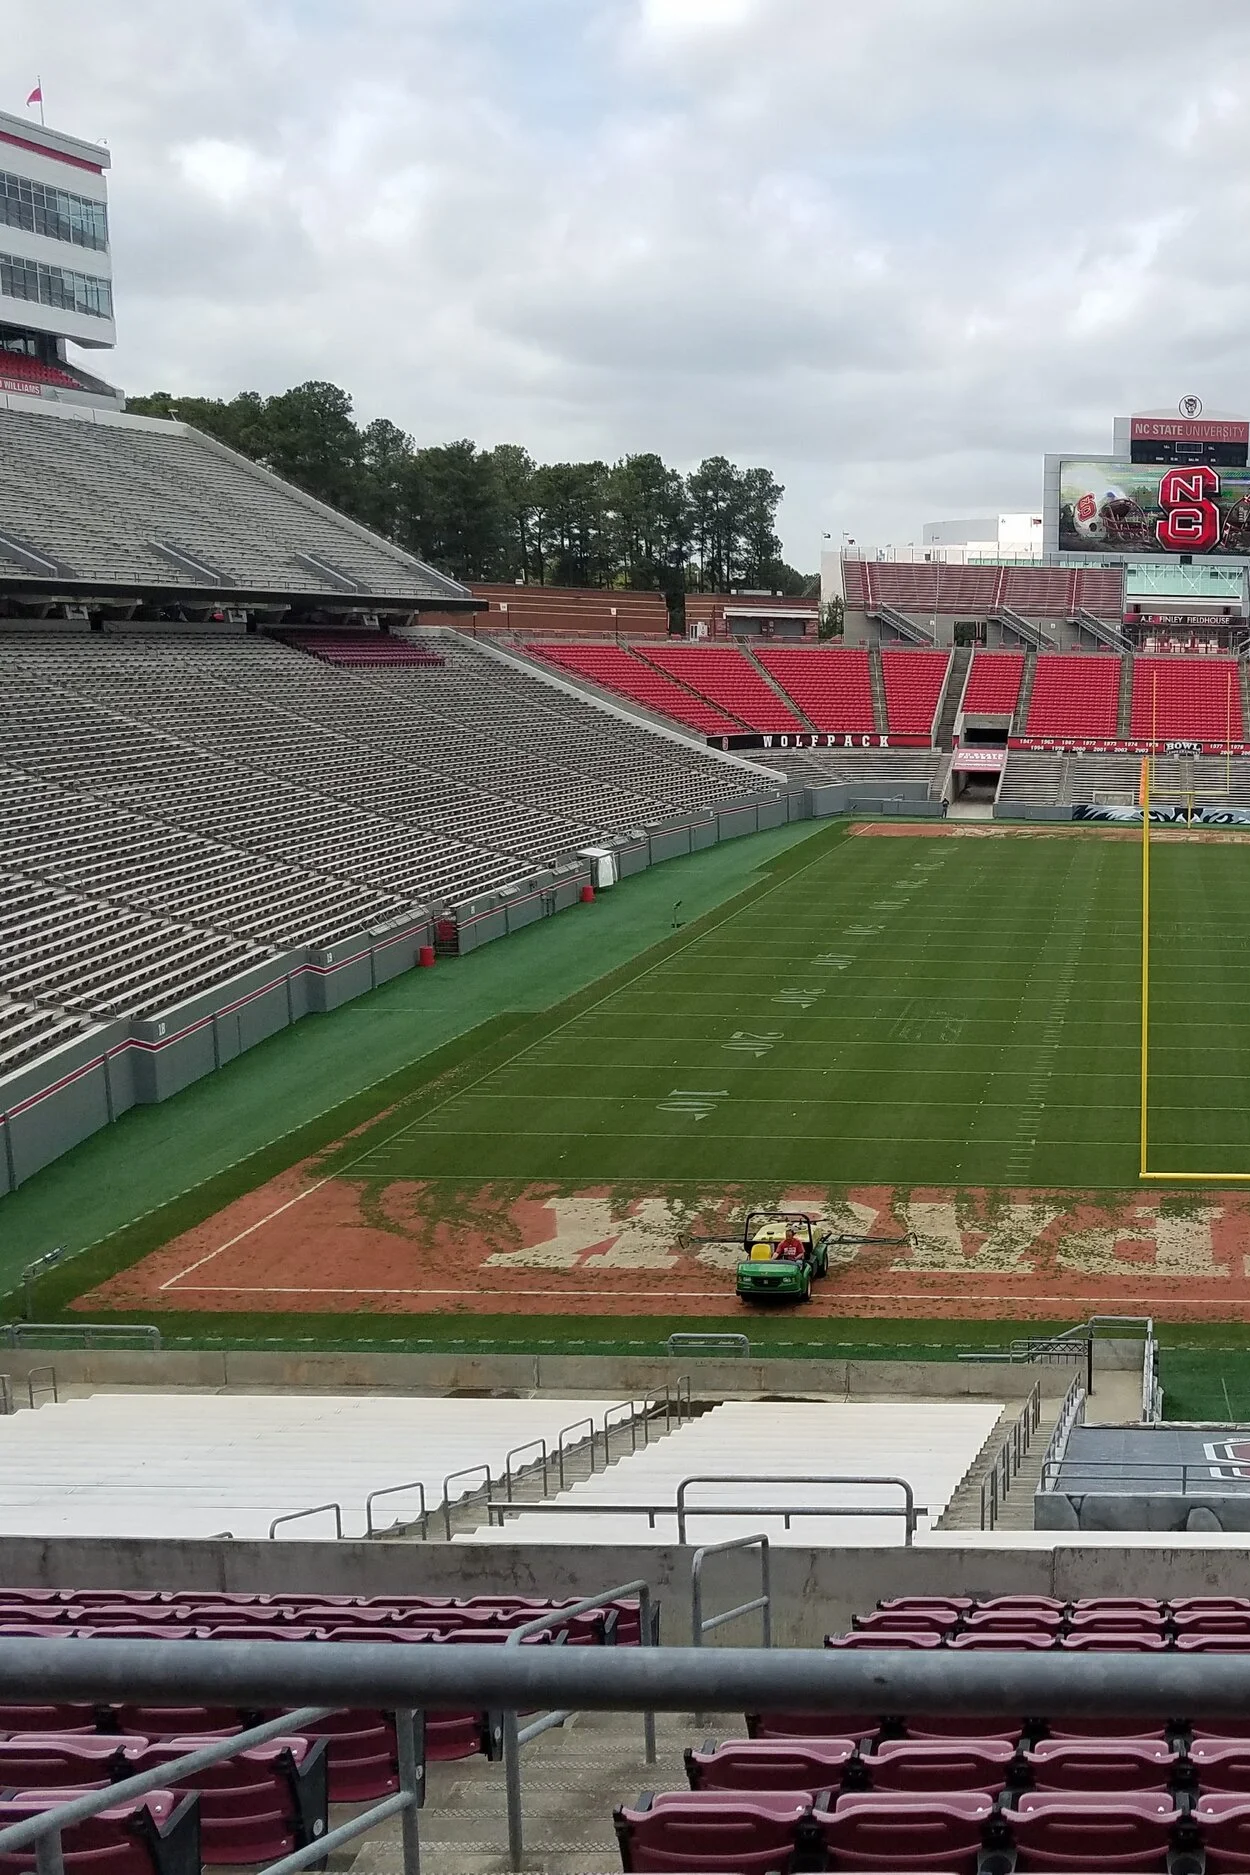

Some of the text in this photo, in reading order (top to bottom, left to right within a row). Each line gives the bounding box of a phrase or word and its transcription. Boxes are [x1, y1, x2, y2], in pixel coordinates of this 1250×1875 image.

[3, 380, 40, 394] WILLIAMS
[1135, 423, 1245, 438] NC STATE UNIVERSITY
[1159, 615, 1184, 625] FINLEY
[1186, 616, 1230, 625] FIELDHOUSE
[763, 735, 889, 748] WOLFPACK
[1166, 742, 1201, 751] BOWL
[655, 1088, 730, 1113] 10
